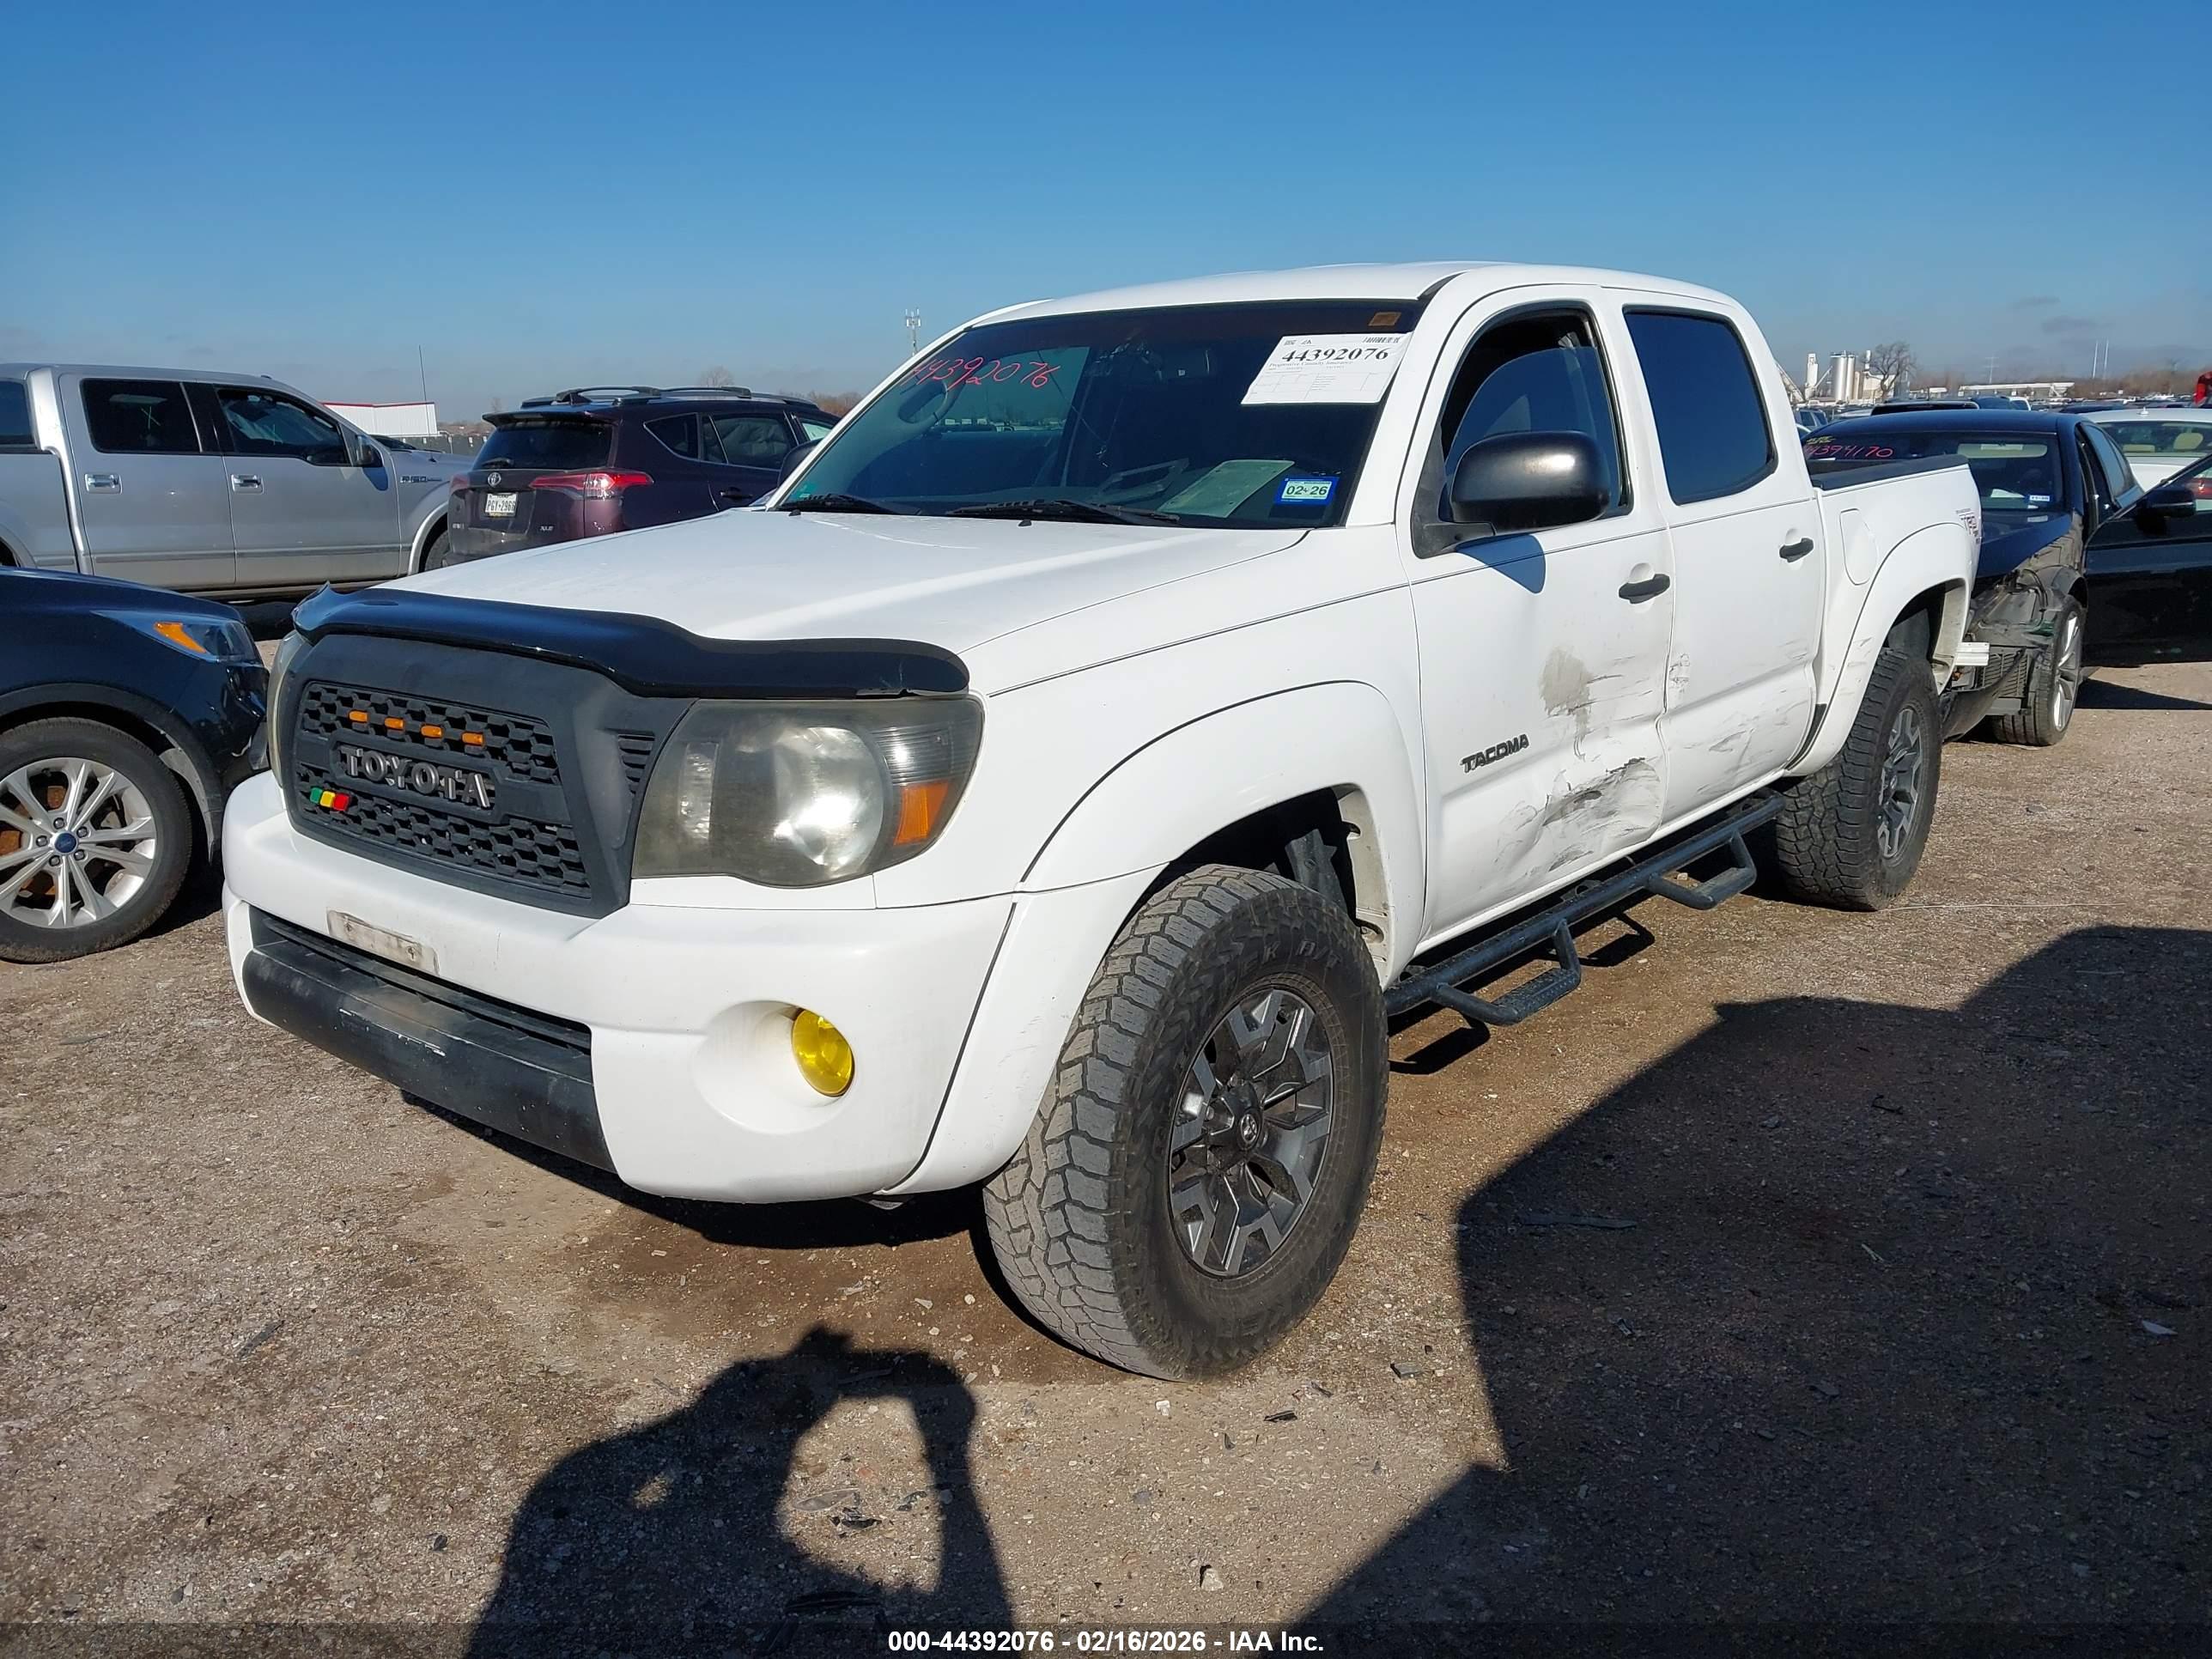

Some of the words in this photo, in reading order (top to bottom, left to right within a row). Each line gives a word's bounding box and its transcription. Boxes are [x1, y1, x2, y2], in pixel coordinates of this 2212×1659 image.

[1281, 347, 1394, 362] 44392076
[1460, 733, 1529, 774] TACOMA
[337, 744, 491, 808] TOYOTA
